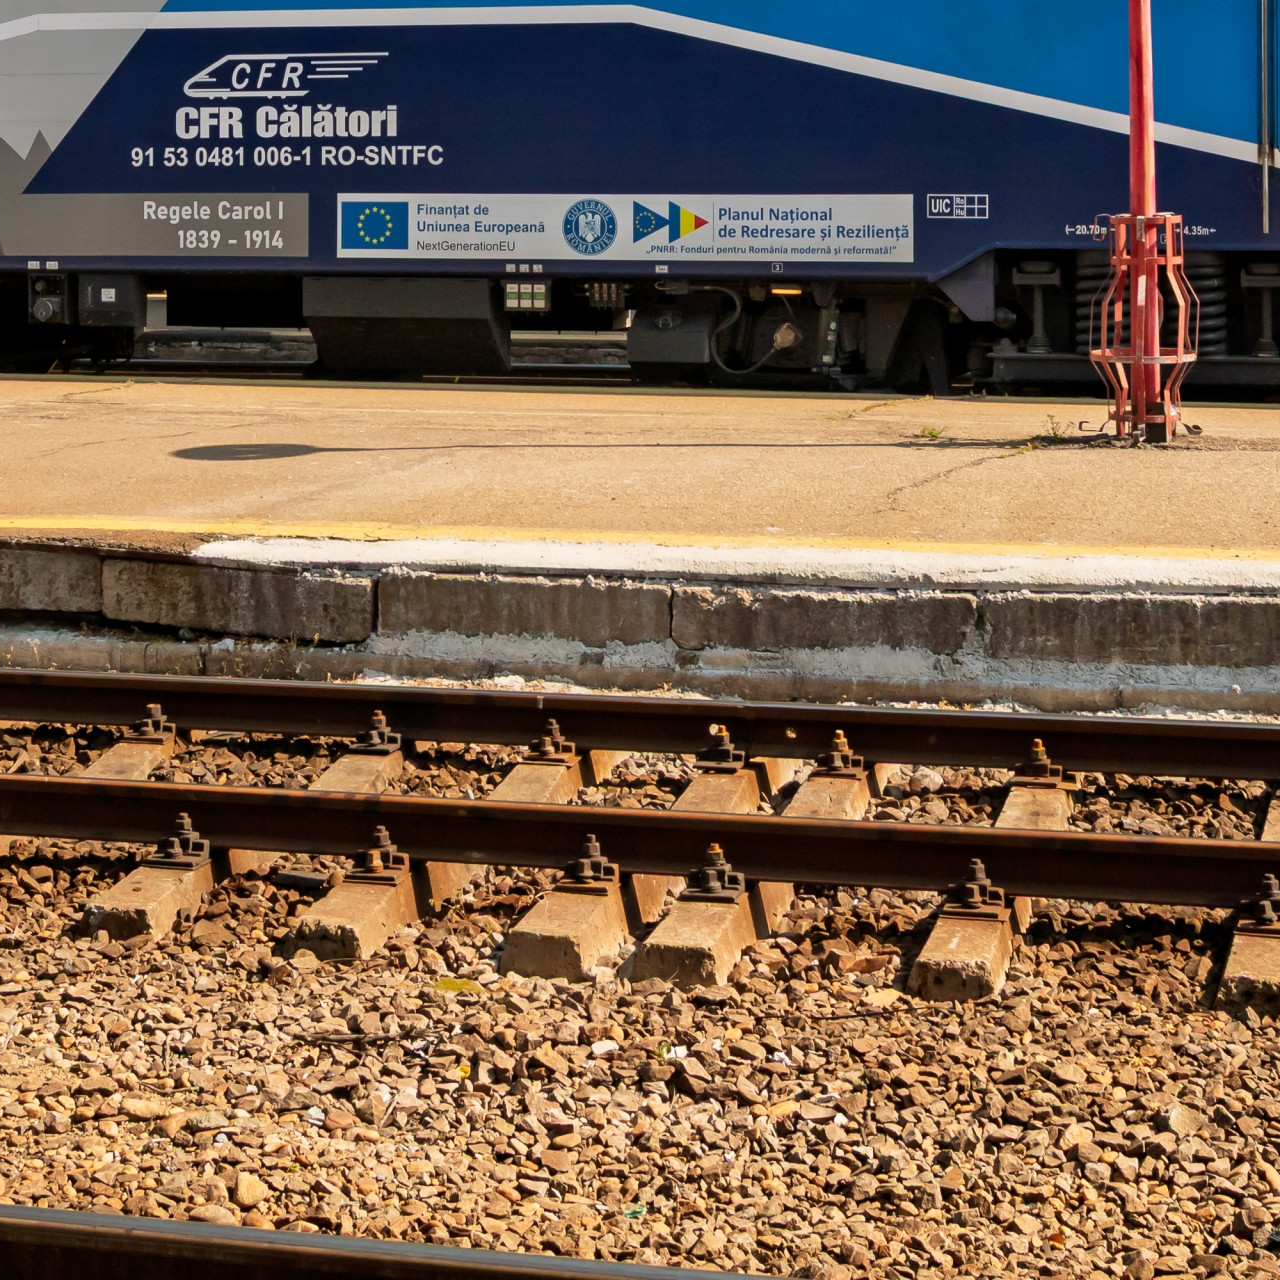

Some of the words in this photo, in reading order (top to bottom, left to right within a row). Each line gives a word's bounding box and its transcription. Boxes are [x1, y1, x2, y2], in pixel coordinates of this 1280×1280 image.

[231, 62, 304, 90] CFR
[175, 106, 244, 139] CFR
[256, 104, 397, 138] Călători
[131, 147, 154, 166] 91
[163, 147, 188, 166] 53
[195, 146, 244, 166] 0481
[253, 146, 312, 166] 006-1
[321, 145, 444, 166] RO-SNTFC
[143, 200, 210, 224] Regele
[218, 200, 271, 220] Carol
[278, 201, 284, 220] I
[417, 204, 470, 218] Finanțat
[474, 204, 489, 215] de
[567, 201, 612, 221] GUVERNUL
[931, 199, 950, 213] UIC
[718, 208, 764, 221] Planul
[769, 208, 832, 224] Național
[417, 221, 470, 232] Uniunea
[474, 221, 545, 235] Europeană
[718, 225, 736, 238] de
[741, 225, 815, 238] Redresare
[820, 225, 831, 242] și
[836, 225, 909, 242] Reziliență
[1076, 225, 1107, 235] 20.70m
[1183, 226, 1209, 235] 4.35m
[178, 230, 220, 248] 1839
[244, 230, 284, 248] 1914
[416, 240, 515, 252] NextGenerationEU
[680, 245, 714, 253] Fonduri
[716, 247, 746, 255] pentru
[749, 245, 788, 254] România
[790, 246, 831, 254] modernă
